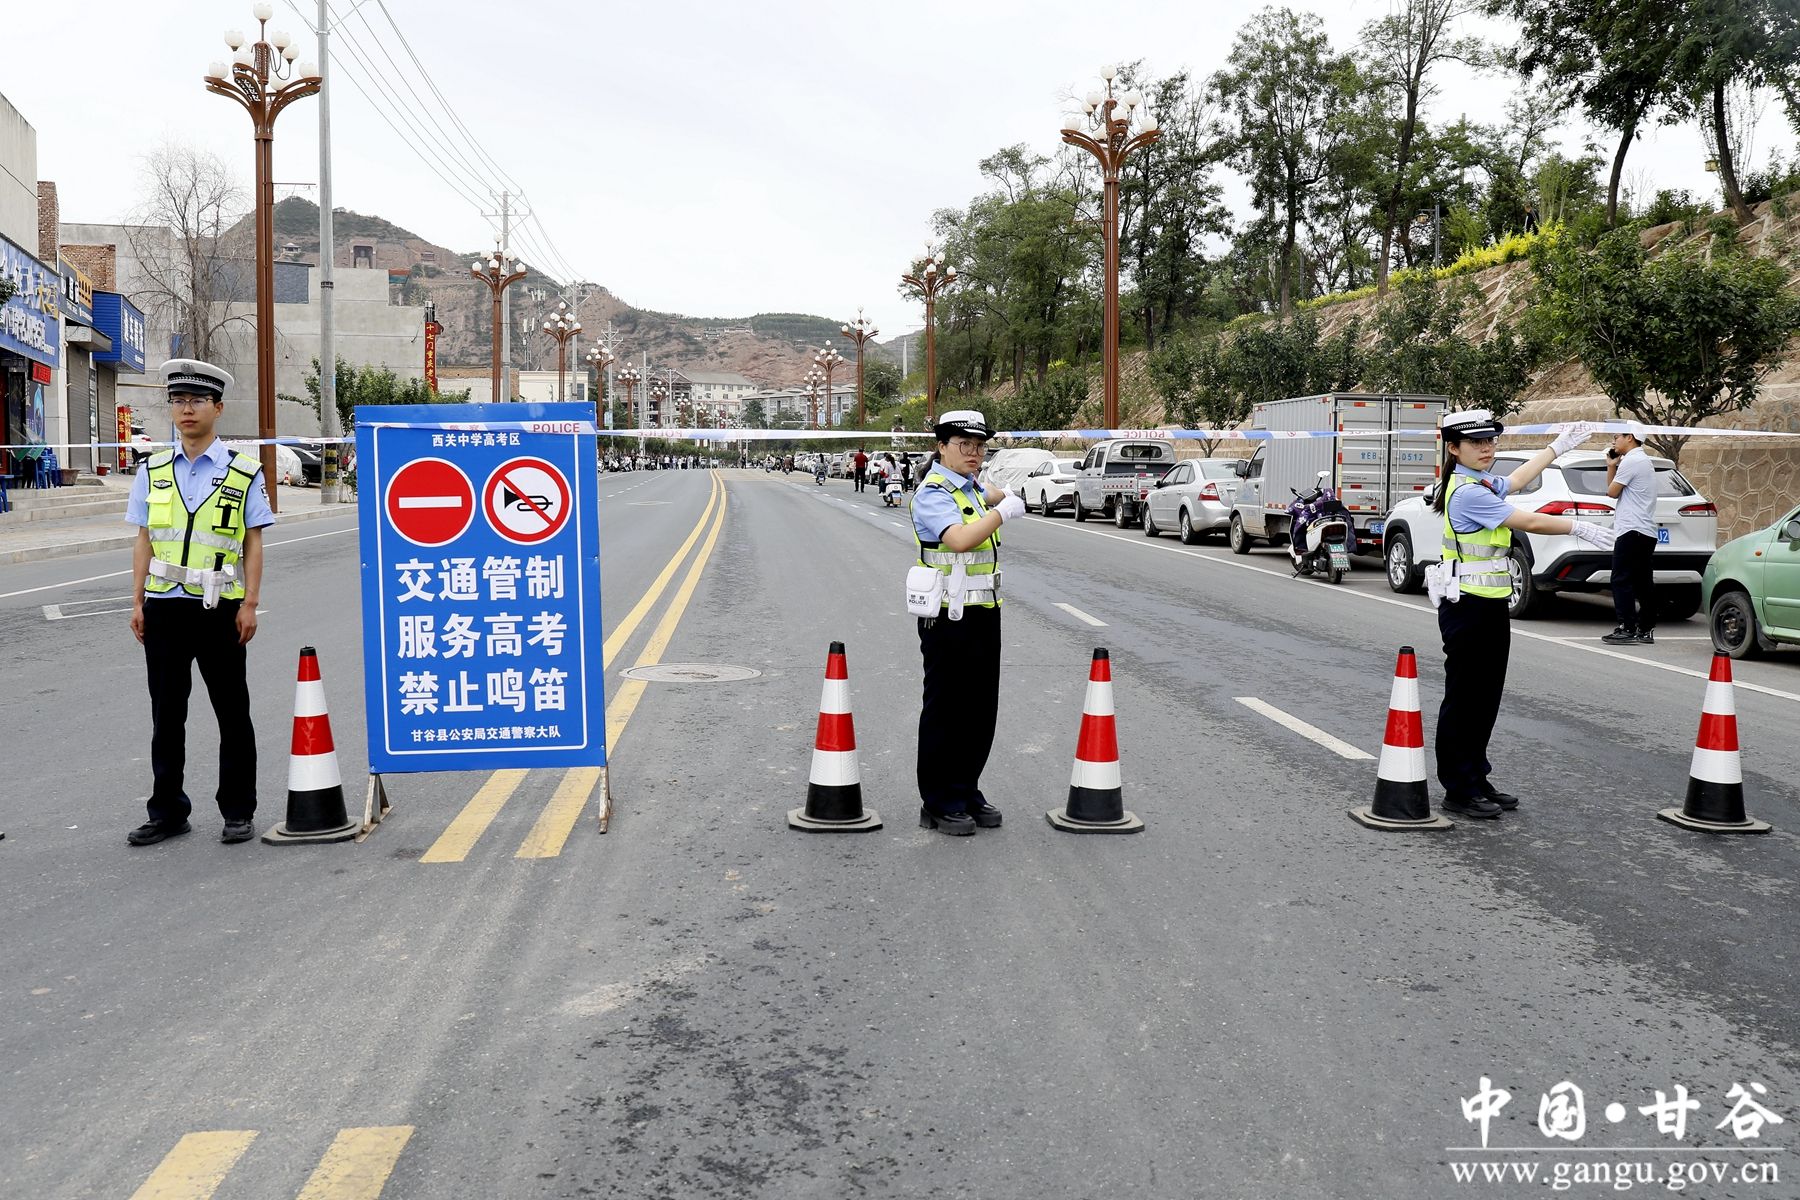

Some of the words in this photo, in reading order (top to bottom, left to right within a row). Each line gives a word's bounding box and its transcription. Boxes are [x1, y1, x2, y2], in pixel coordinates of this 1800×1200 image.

[432, 433, 521, 448] 西关中学高考区
[532, 422, 581, 434] POLICE
[395, 555, 565, 603] 交通管制
[397, 611, 568, 659] 服务高考
[398, 667, 569, 716] 禁止鸣笛
[411, 725, 561, 742] 甘谷县公安局交通警察大队
